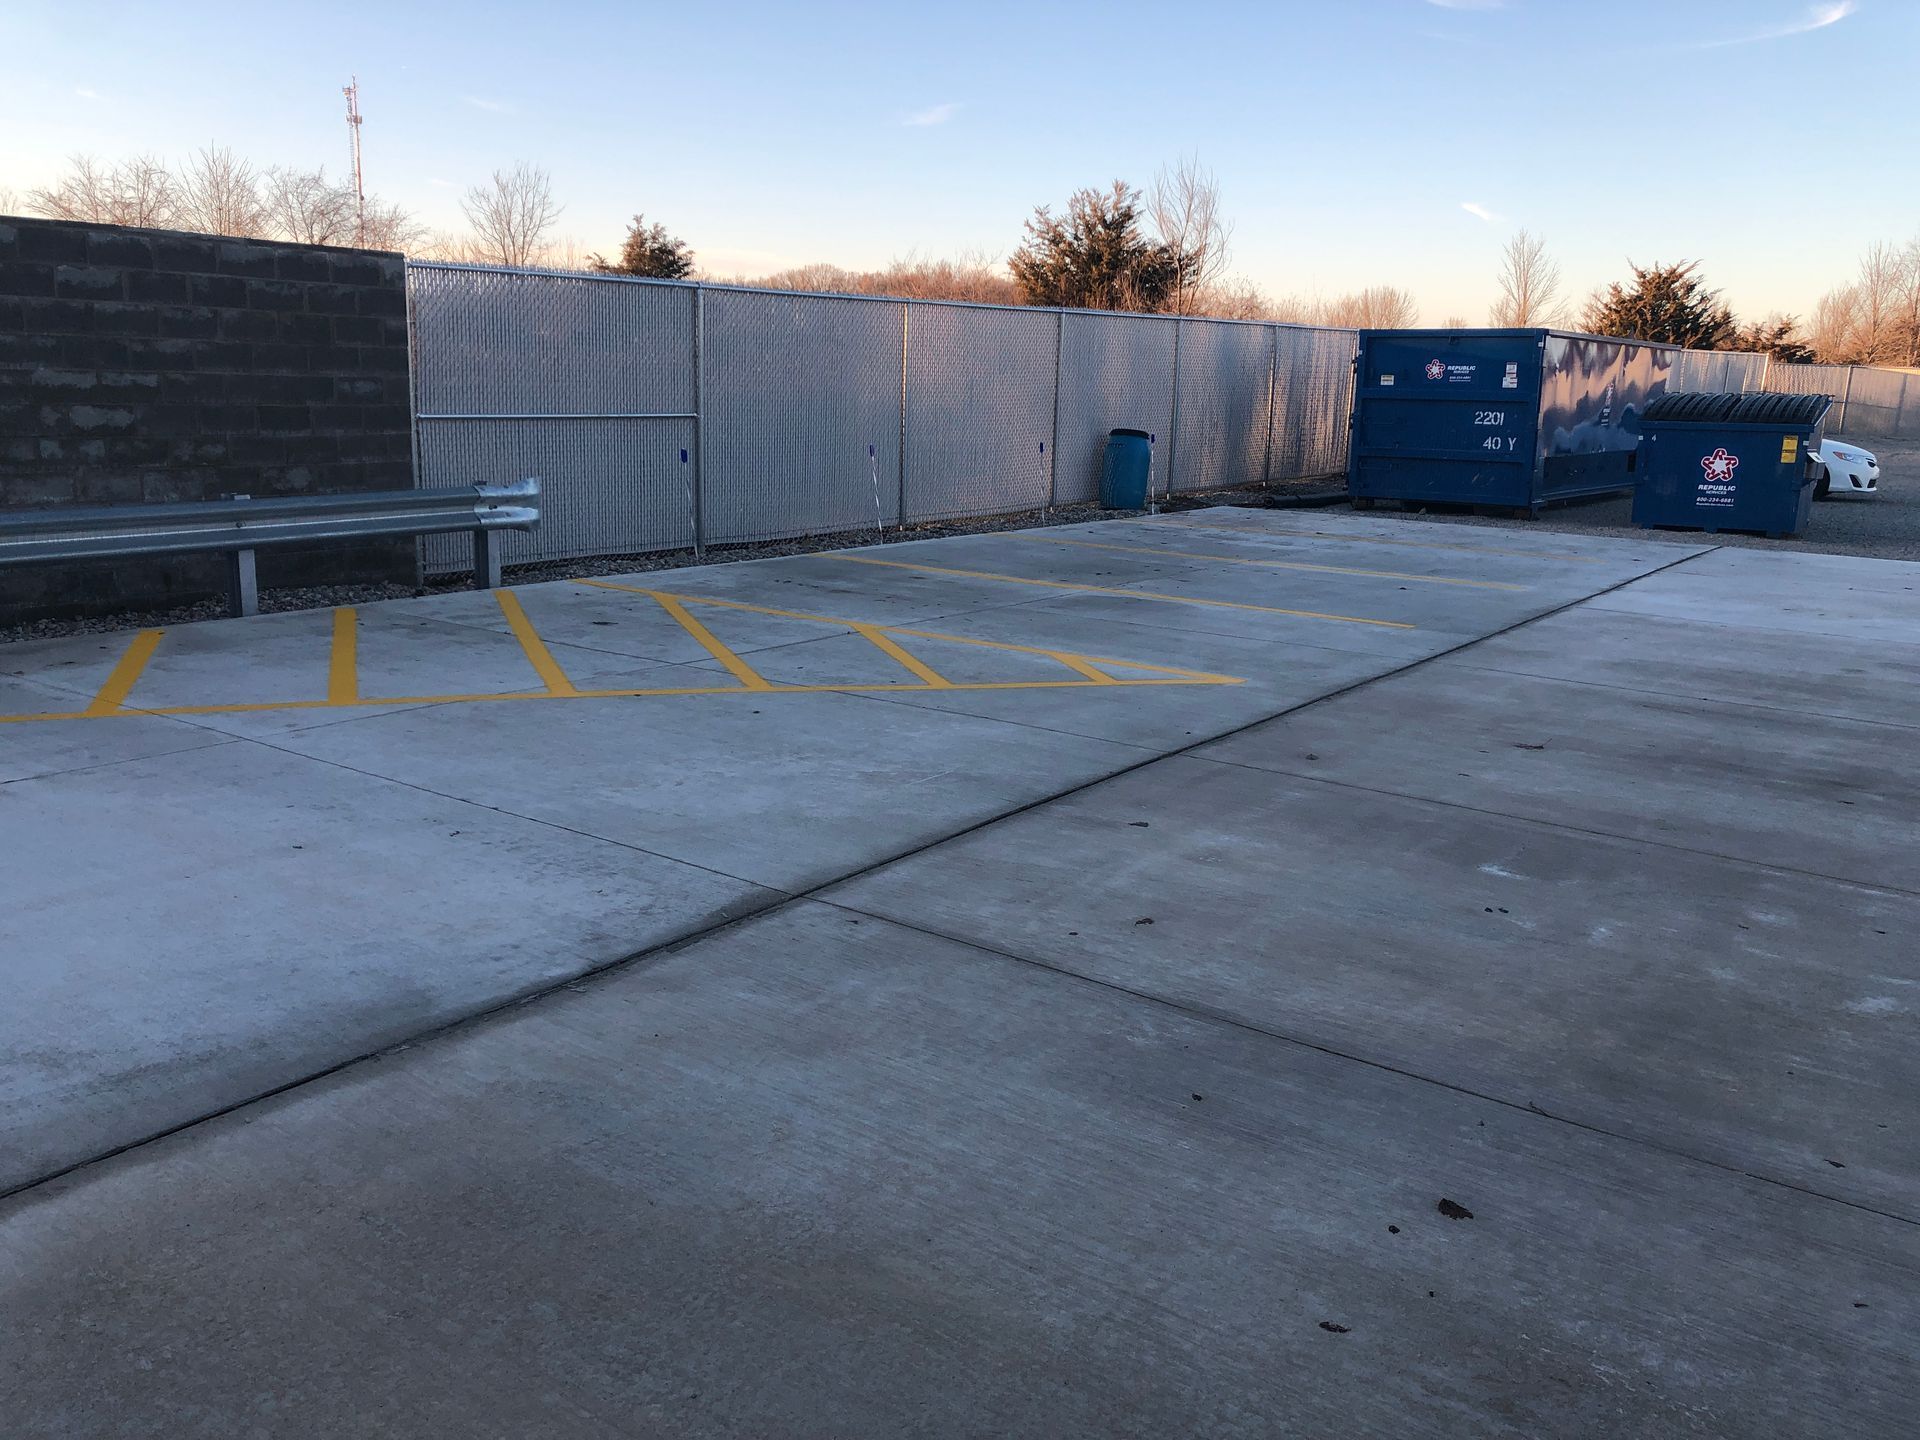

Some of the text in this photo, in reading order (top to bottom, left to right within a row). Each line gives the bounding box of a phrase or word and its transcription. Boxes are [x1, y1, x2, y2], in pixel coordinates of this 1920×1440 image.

[1474, 411, 1504, 425] 2201
[1482, 436, 1517, 451] 40 Y
